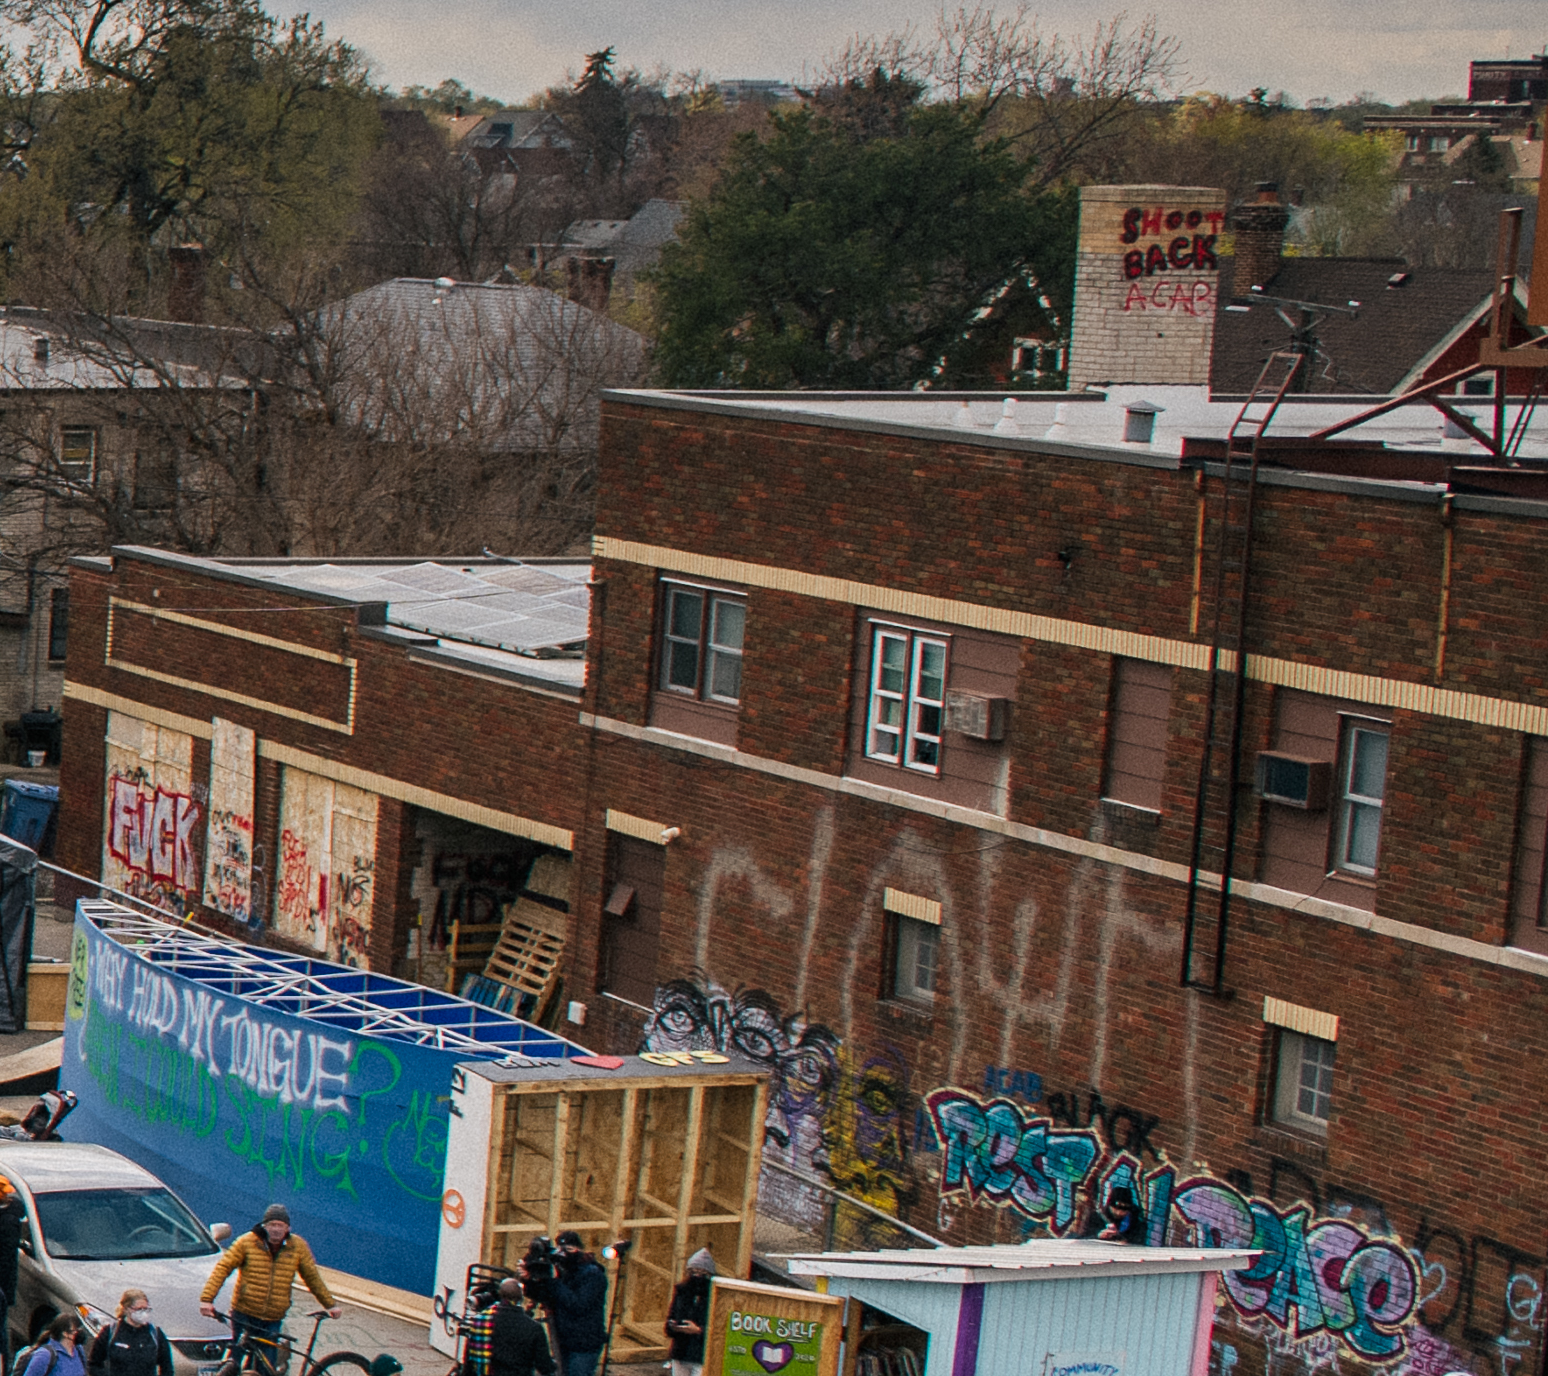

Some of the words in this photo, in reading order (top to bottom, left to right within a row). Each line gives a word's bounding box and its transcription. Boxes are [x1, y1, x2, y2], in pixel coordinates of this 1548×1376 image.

[1120, 207, 1225, 244] SHOOT
[1123, 233, 1218, 279] BACK
[1124, 281, 1213, 315] ACAB
[109, 776, 202, 896] FUCK
[731, 1311, 772, 1333] BOOK
[776, 1314, 818, 1338] SHELF
